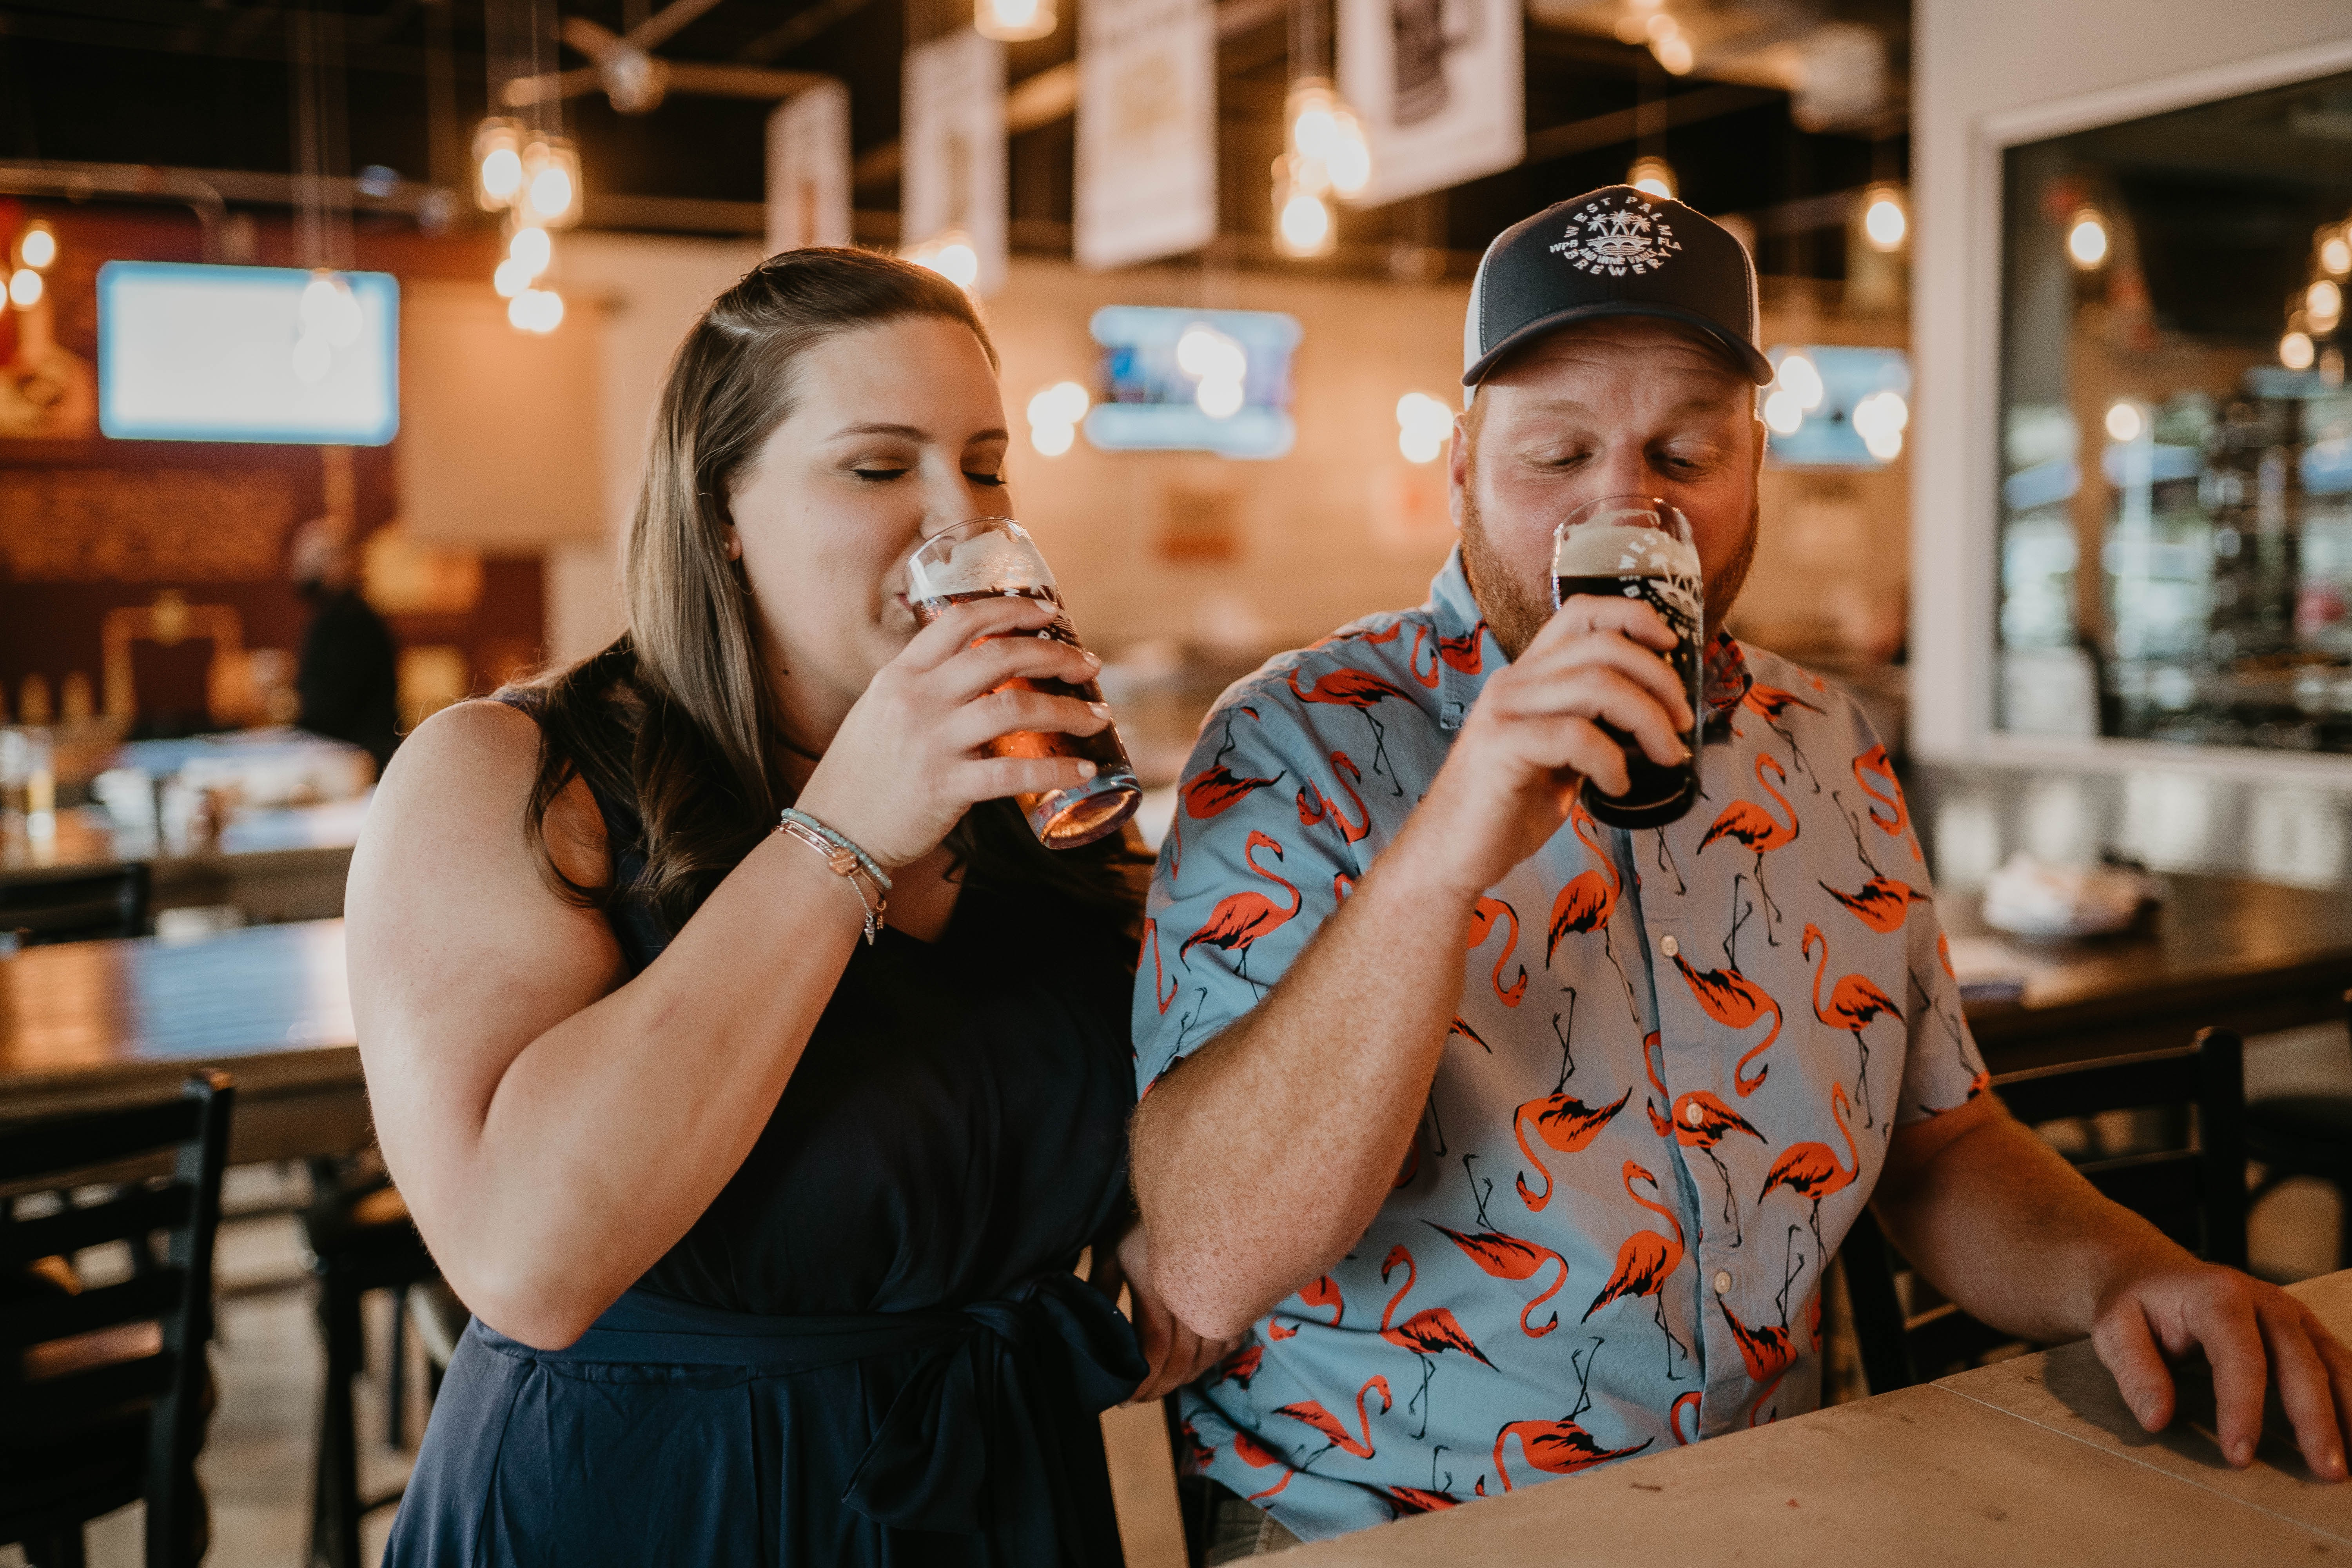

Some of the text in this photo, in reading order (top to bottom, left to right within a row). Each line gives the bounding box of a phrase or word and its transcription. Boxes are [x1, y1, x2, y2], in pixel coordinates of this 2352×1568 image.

[1564, 196, 1673, 238] WEST PALM
[1550, 240, 1579, 252] WPB
[1658, 237, 1682, 250] FLA
[1564, 249, 1671, 276] BREWERY
